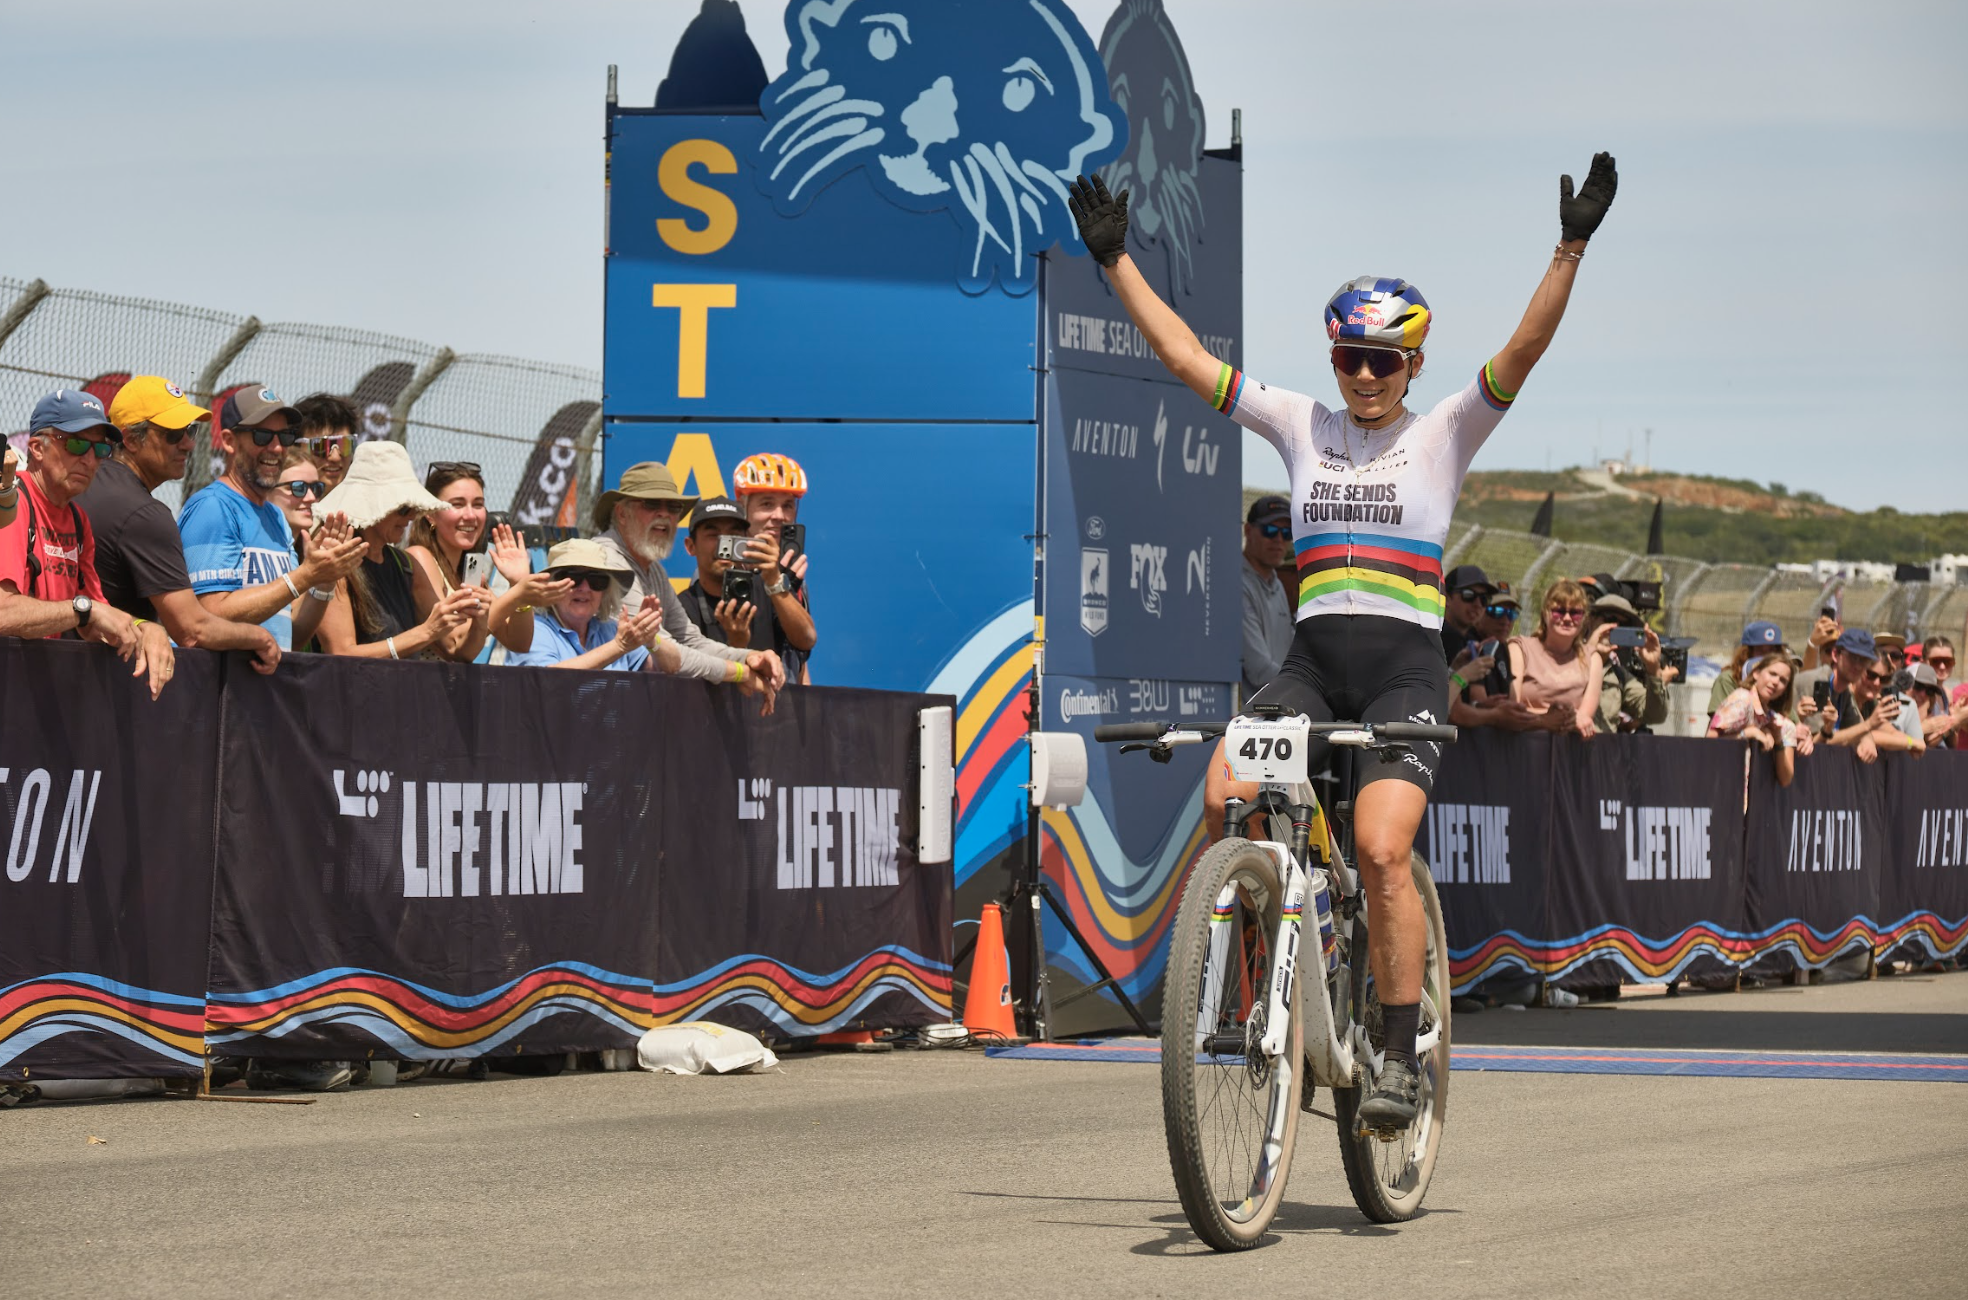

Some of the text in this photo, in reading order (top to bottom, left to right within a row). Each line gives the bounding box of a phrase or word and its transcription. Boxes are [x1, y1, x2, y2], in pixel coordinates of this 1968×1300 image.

[1347, 315, 1385, 327] Red Bull
[1109, 321, 1131, 357] SEA
[83, 401, 101, 411] FILA
[1072, 418, 1138, 459] AVENTON
[1323, 462, 1345, 473] UCI
[1310, 480, 1397, 503] SHE SENDS
[1303, 502, 1403, 526] FOUNDATION
[1130, 543, 1167, 610] FOX
[1060, 687, 1112, 724] Continental
[1239, 737, 1292, 761] 470
[1403, 753, 1433, 788] Raph
[0, 767, 101, 883] ON
[1787, 809, 1862, 872] AVENTON
